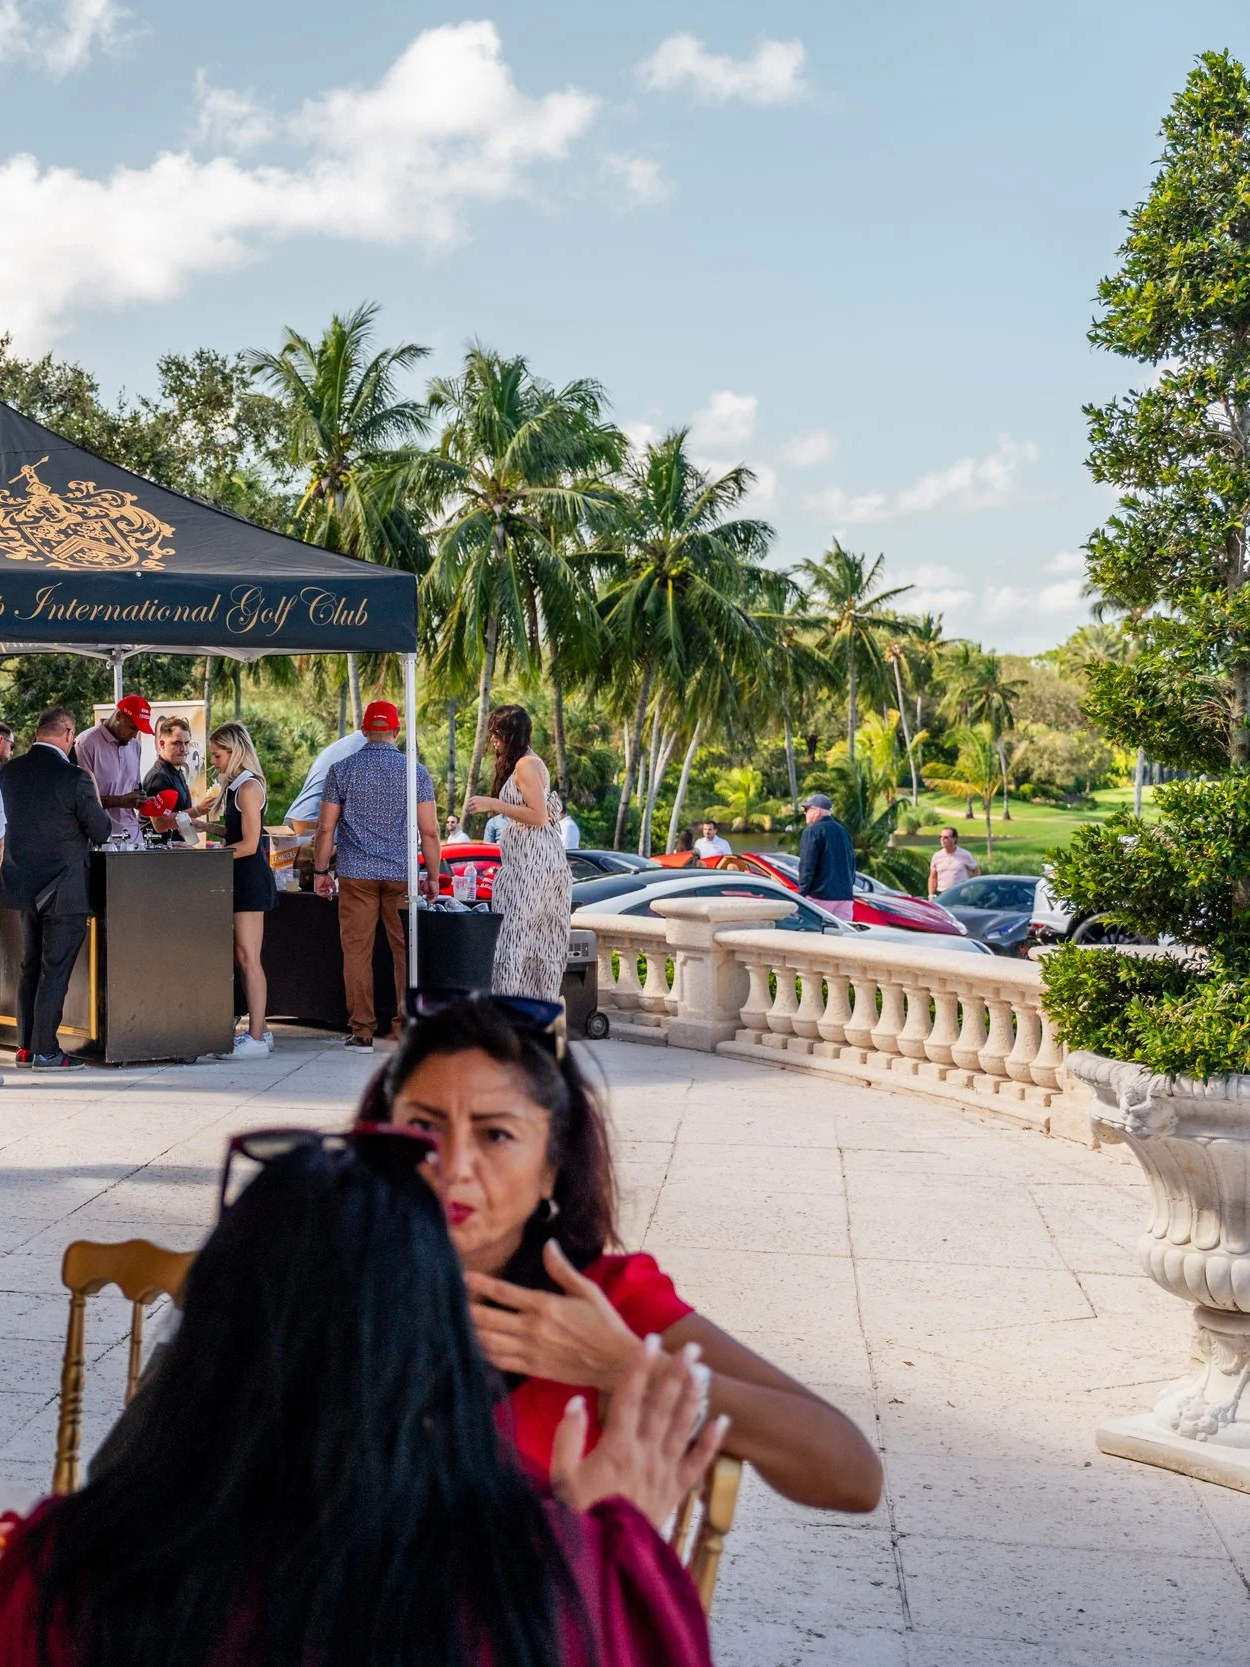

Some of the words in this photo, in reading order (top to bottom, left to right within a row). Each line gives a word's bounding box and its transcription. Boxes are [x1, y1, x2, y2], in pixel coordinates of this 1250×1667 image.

[14, 582, 222, 623] International
[226, 584, 298, 637] Golf
[300, 586, 369, 627] Club
